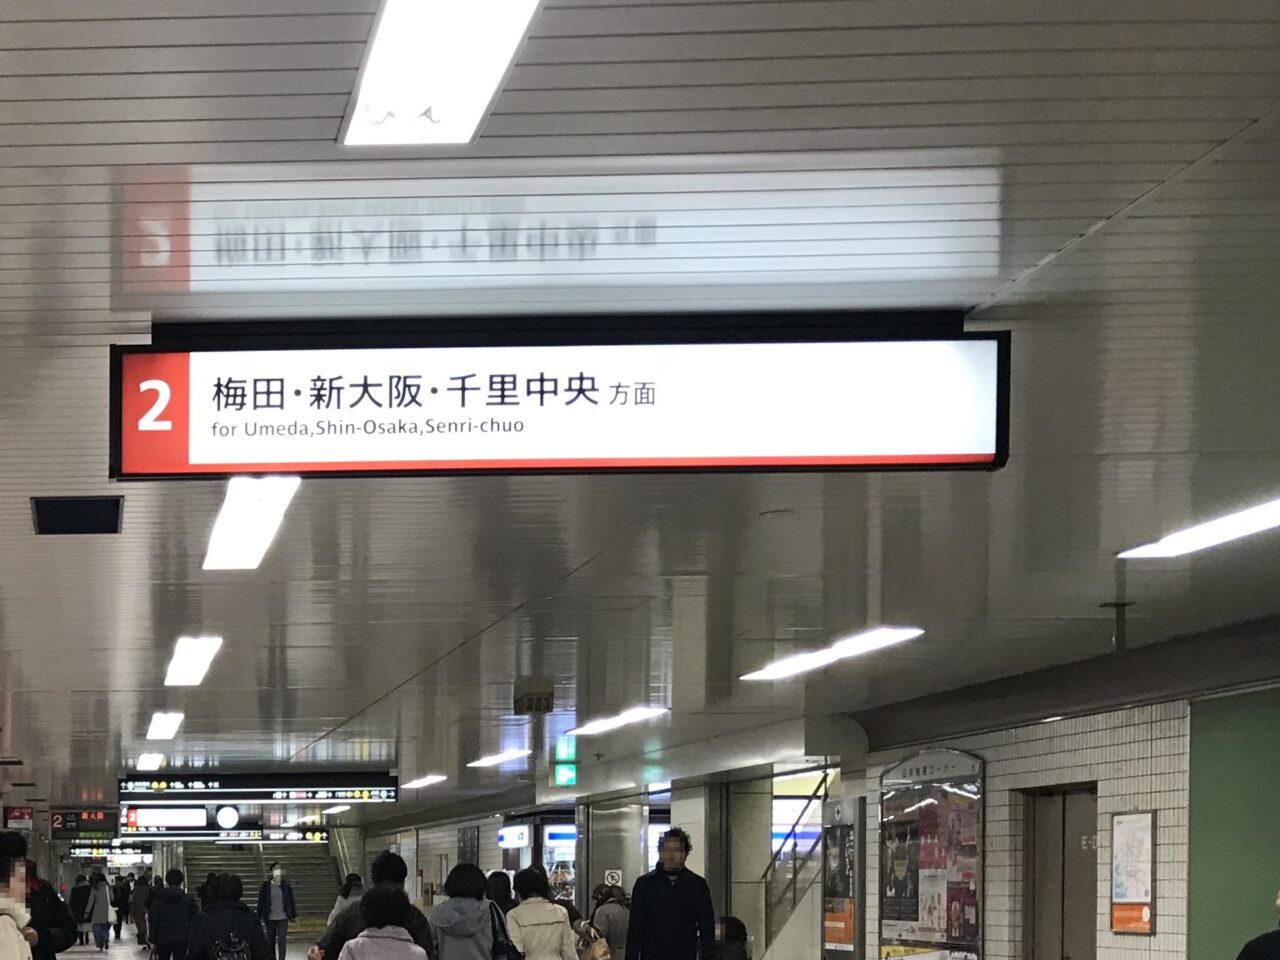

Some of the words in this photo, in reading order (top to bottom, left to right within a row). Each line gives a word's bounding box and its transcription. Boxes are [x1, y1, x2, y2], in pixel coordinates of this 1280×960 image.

[138, 379, 172, 431] 2
[211, 371, 600, 412] 梅田・新大阪・千里中央
[609, 381, 656, 406] 方面
[211, 420, 238, 438] for
[52, 814, 63, 828] 2
